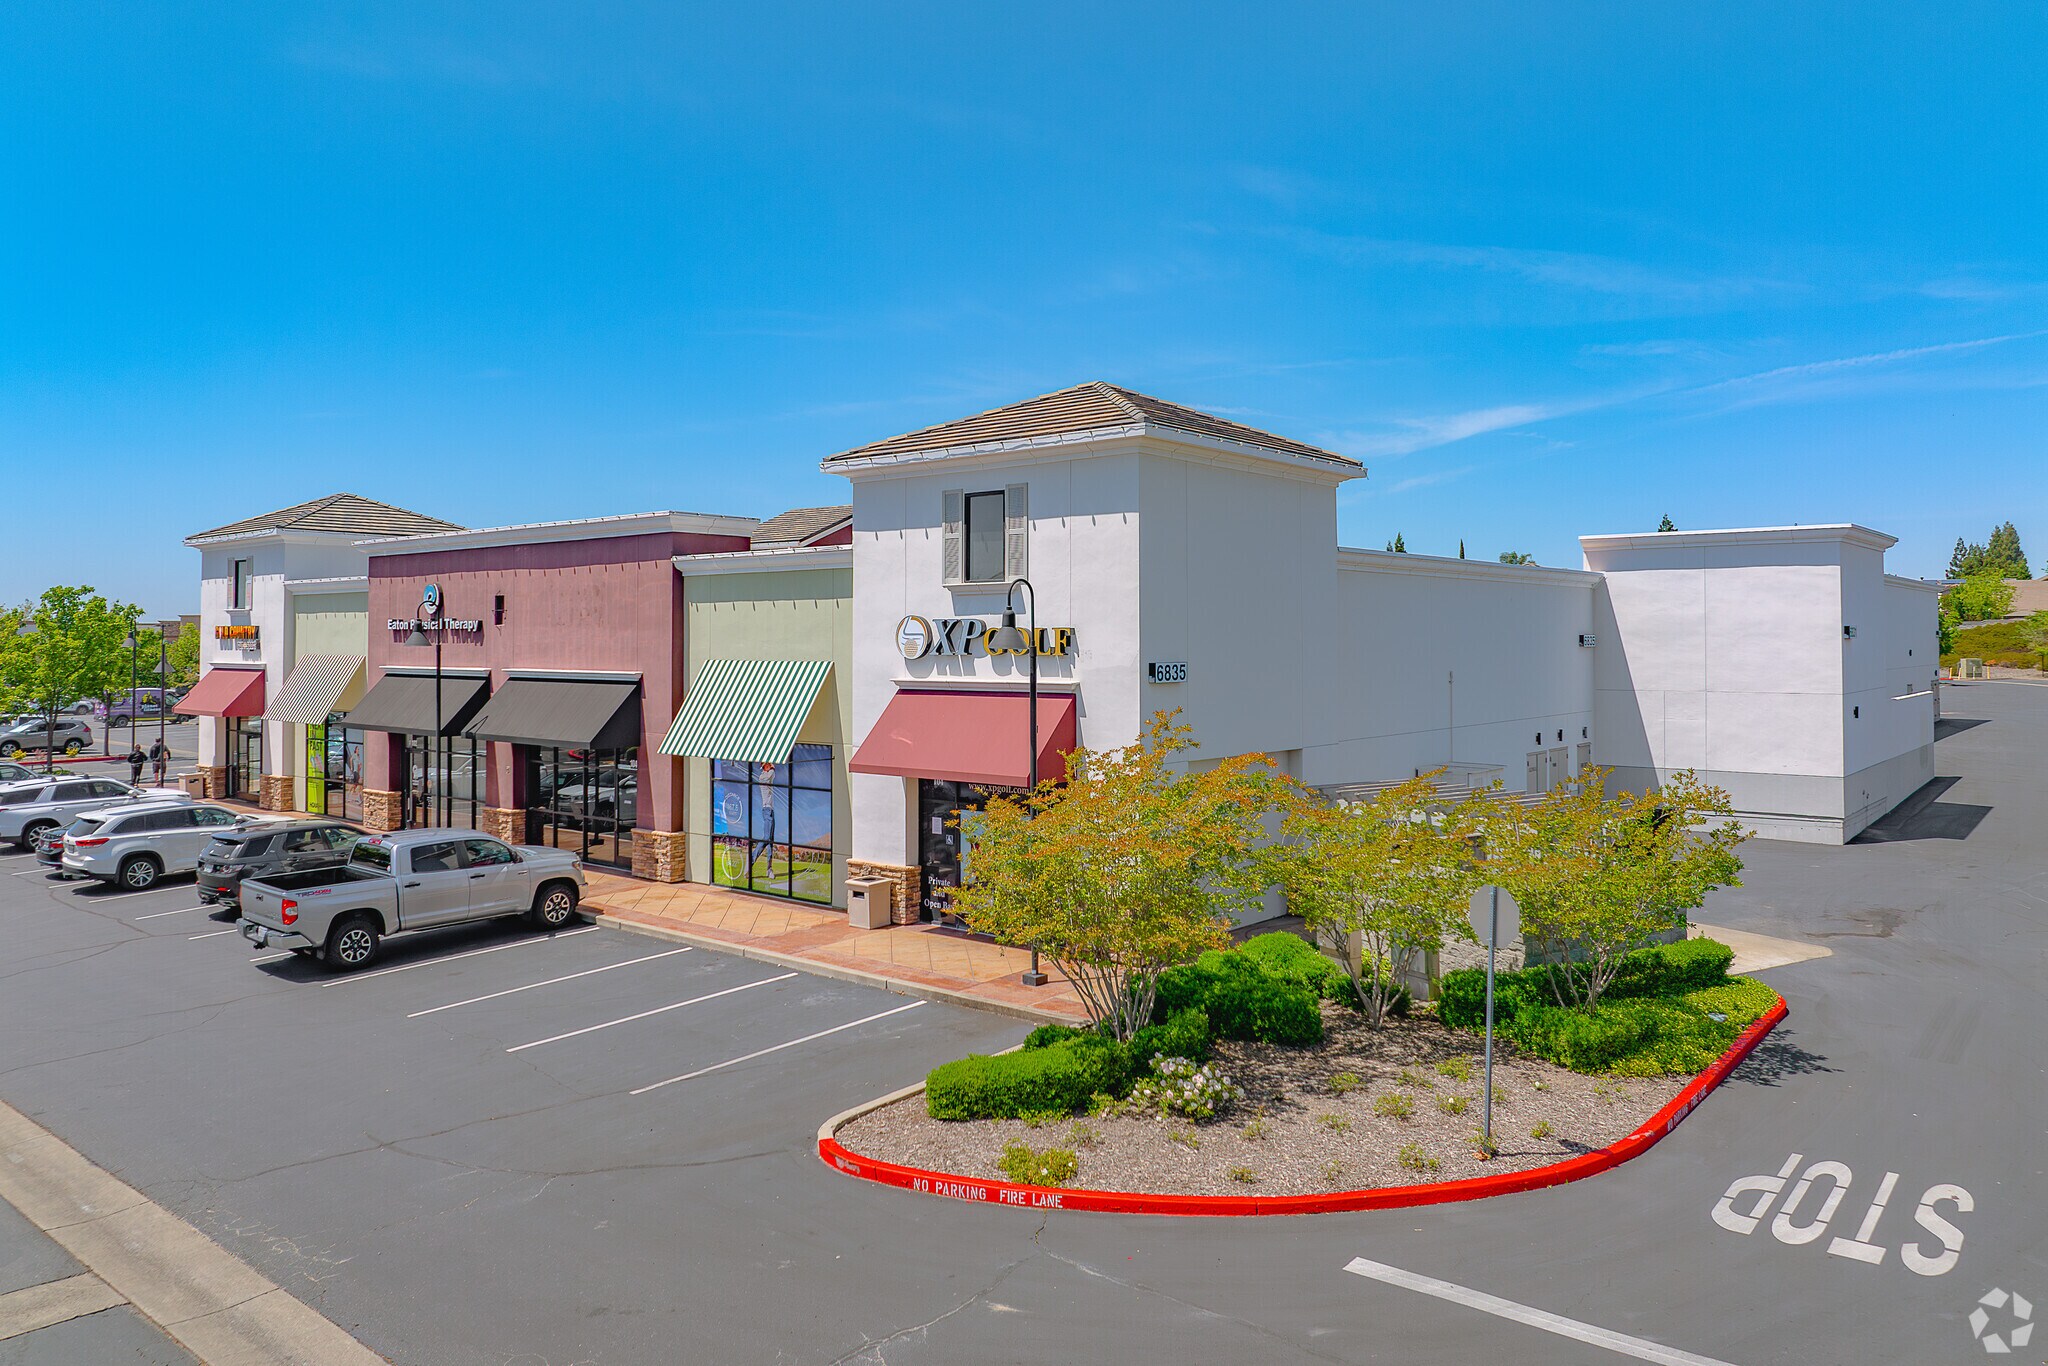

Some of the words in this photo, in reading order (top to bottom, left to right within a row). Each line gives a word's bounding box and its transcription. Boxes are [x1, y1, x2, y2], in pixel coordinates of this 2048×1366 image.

[387, 619, 409, 630] Eaton
[410, 619, 443, 630] Psical
[444, 618, 479, 632] Therapy
[929, 618, 985, 656] XP
[1156, 664, 1187, 682] 6835
[928, 876, 951, 887] Private
[923, 898, 942, 909] Open
[913, 1177, 930, 1193] NO
[935, 1182, 988, 1201] PARKING
[999, 1189, 1027, 1205] FIRE
[1031, 1192, 1064, 1209] LANE
[1710, 1152, 1975, 1277] STOP
